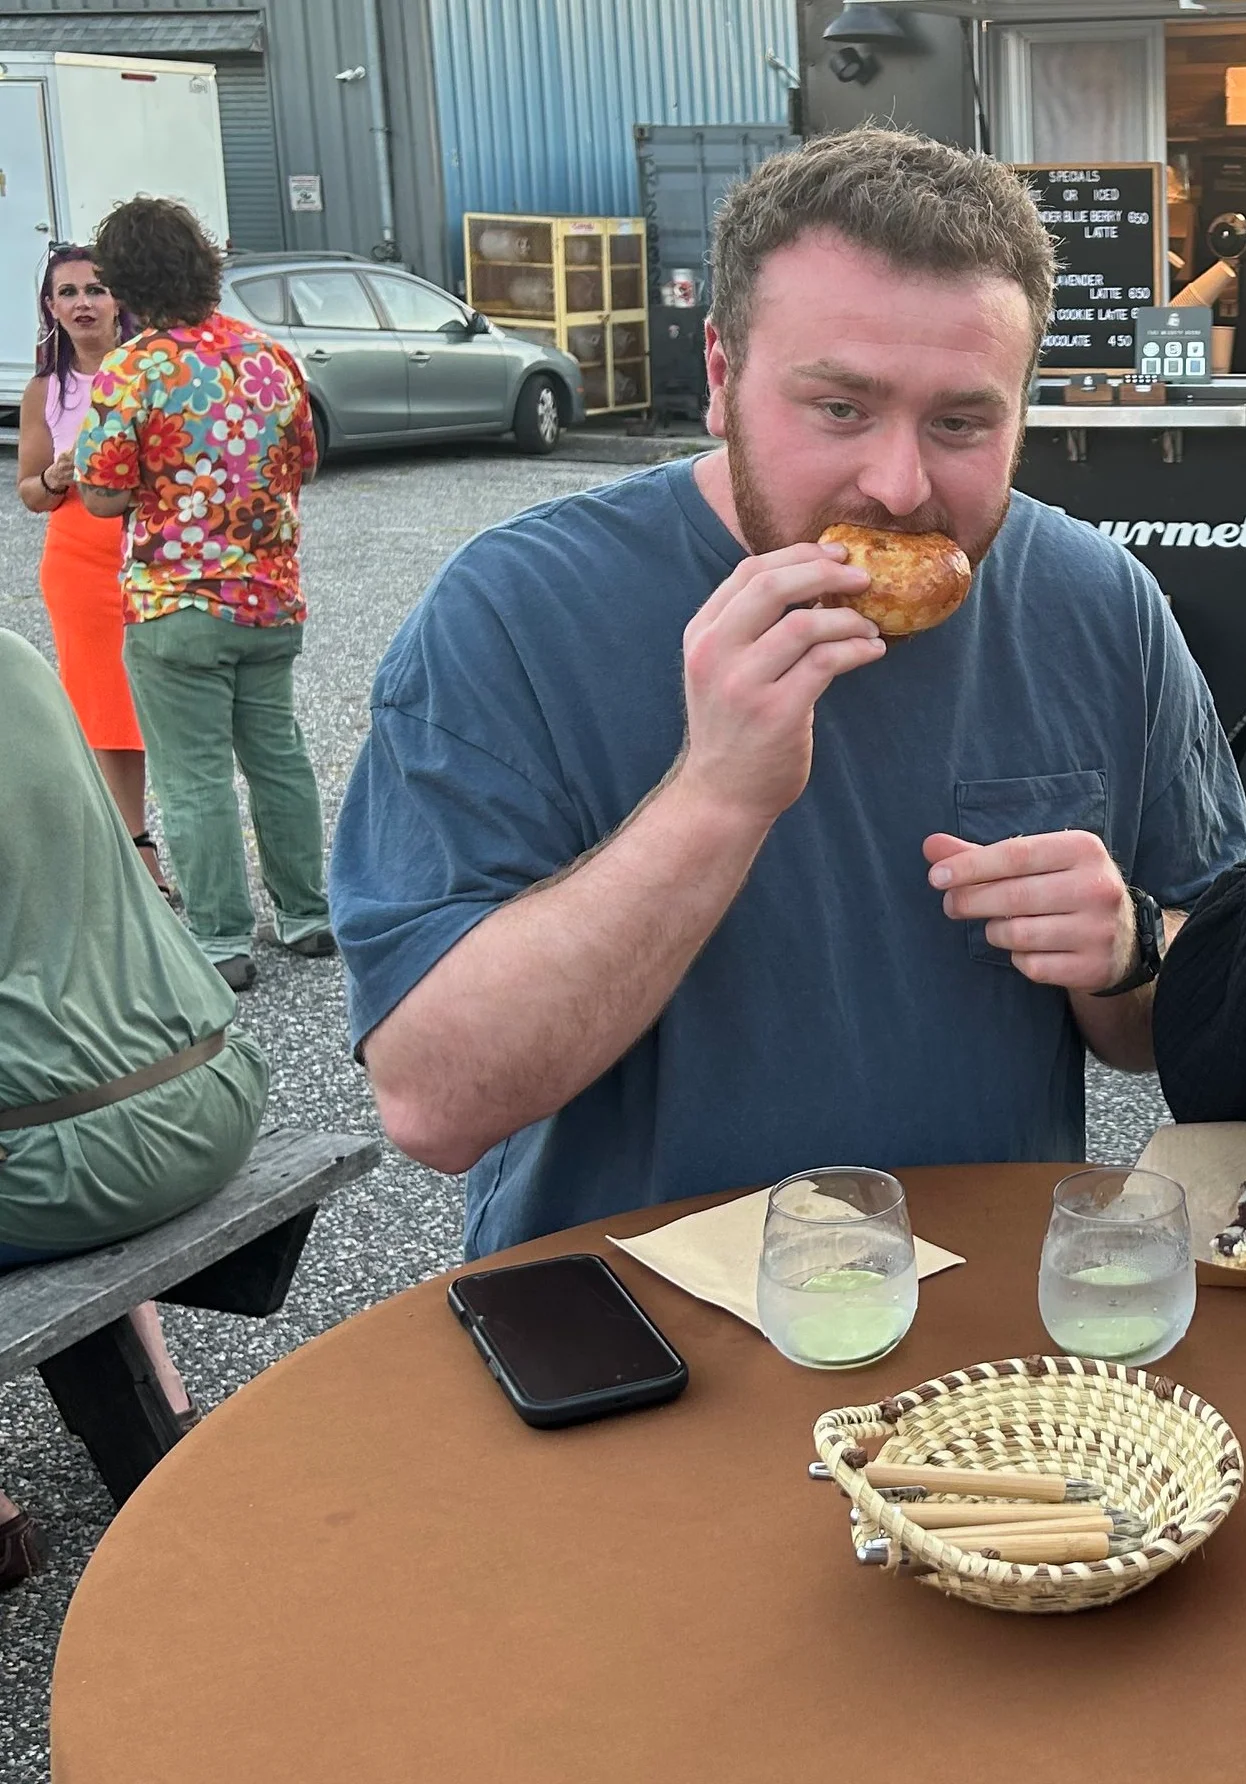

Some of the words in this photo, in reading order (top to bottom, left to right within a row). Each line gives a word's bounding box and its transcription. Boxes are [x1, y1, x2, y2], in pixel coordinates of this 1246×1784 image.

[1049, 170, 1101, 183] SPECIALS
[1062, 189, 1079, 201] OR
[1093, 188, 1120, 201] ICED
[1084, 227, 1119, 238] LATTE
[1055, 274, 1104, 287] AVENDER
[1089, 288, 1123, 299] LATTE
[1128, 287, 1150, 299] 650
[1041, 334, 1092, 347] HOCOLATE
[1107, 334, 1133, 347] 450
